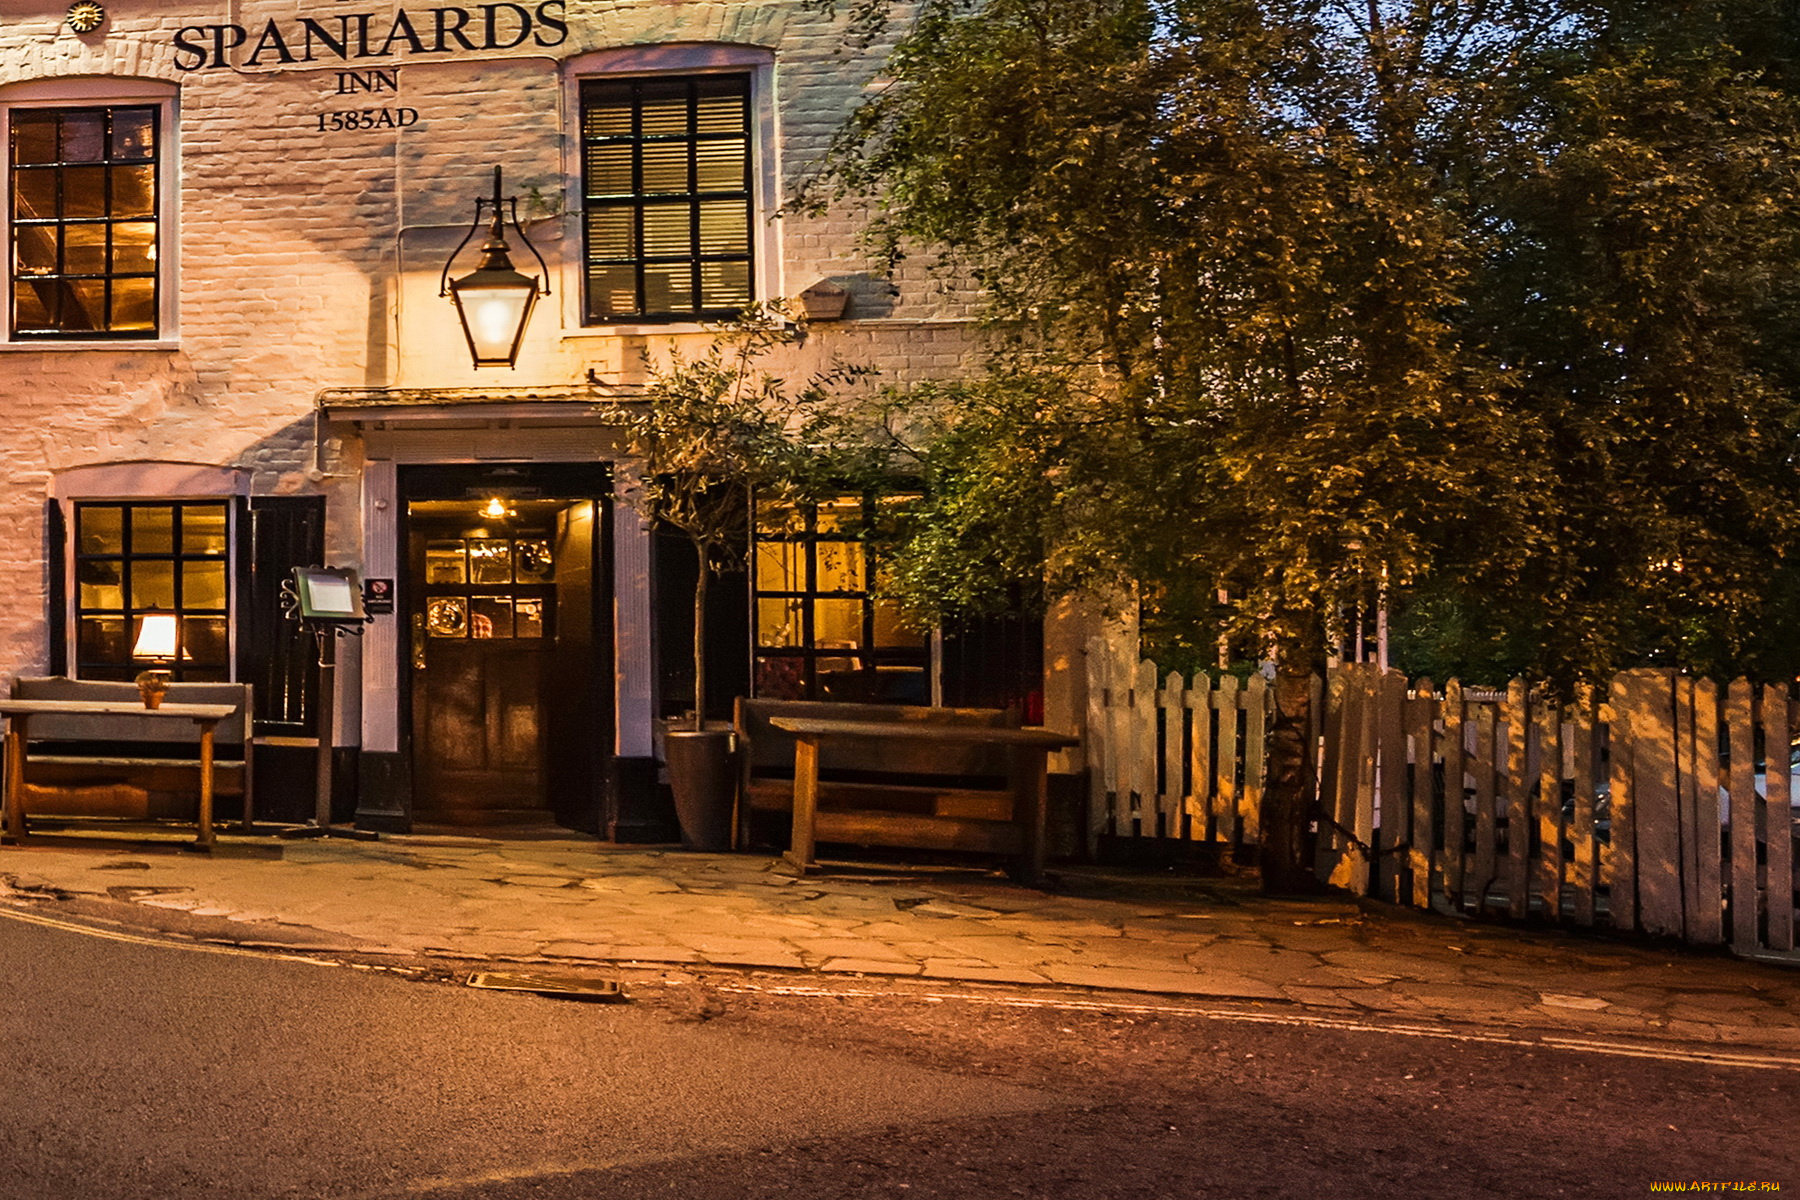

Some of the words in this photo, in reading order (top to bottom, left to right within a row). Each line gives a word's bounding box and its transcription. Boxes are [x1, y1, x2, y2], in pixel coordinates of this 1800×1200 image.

[173, 0, 569, 71] SPANIARDS
[335, 69, 400, 95] INN
[316, 107, 419, 132] 1585AD
